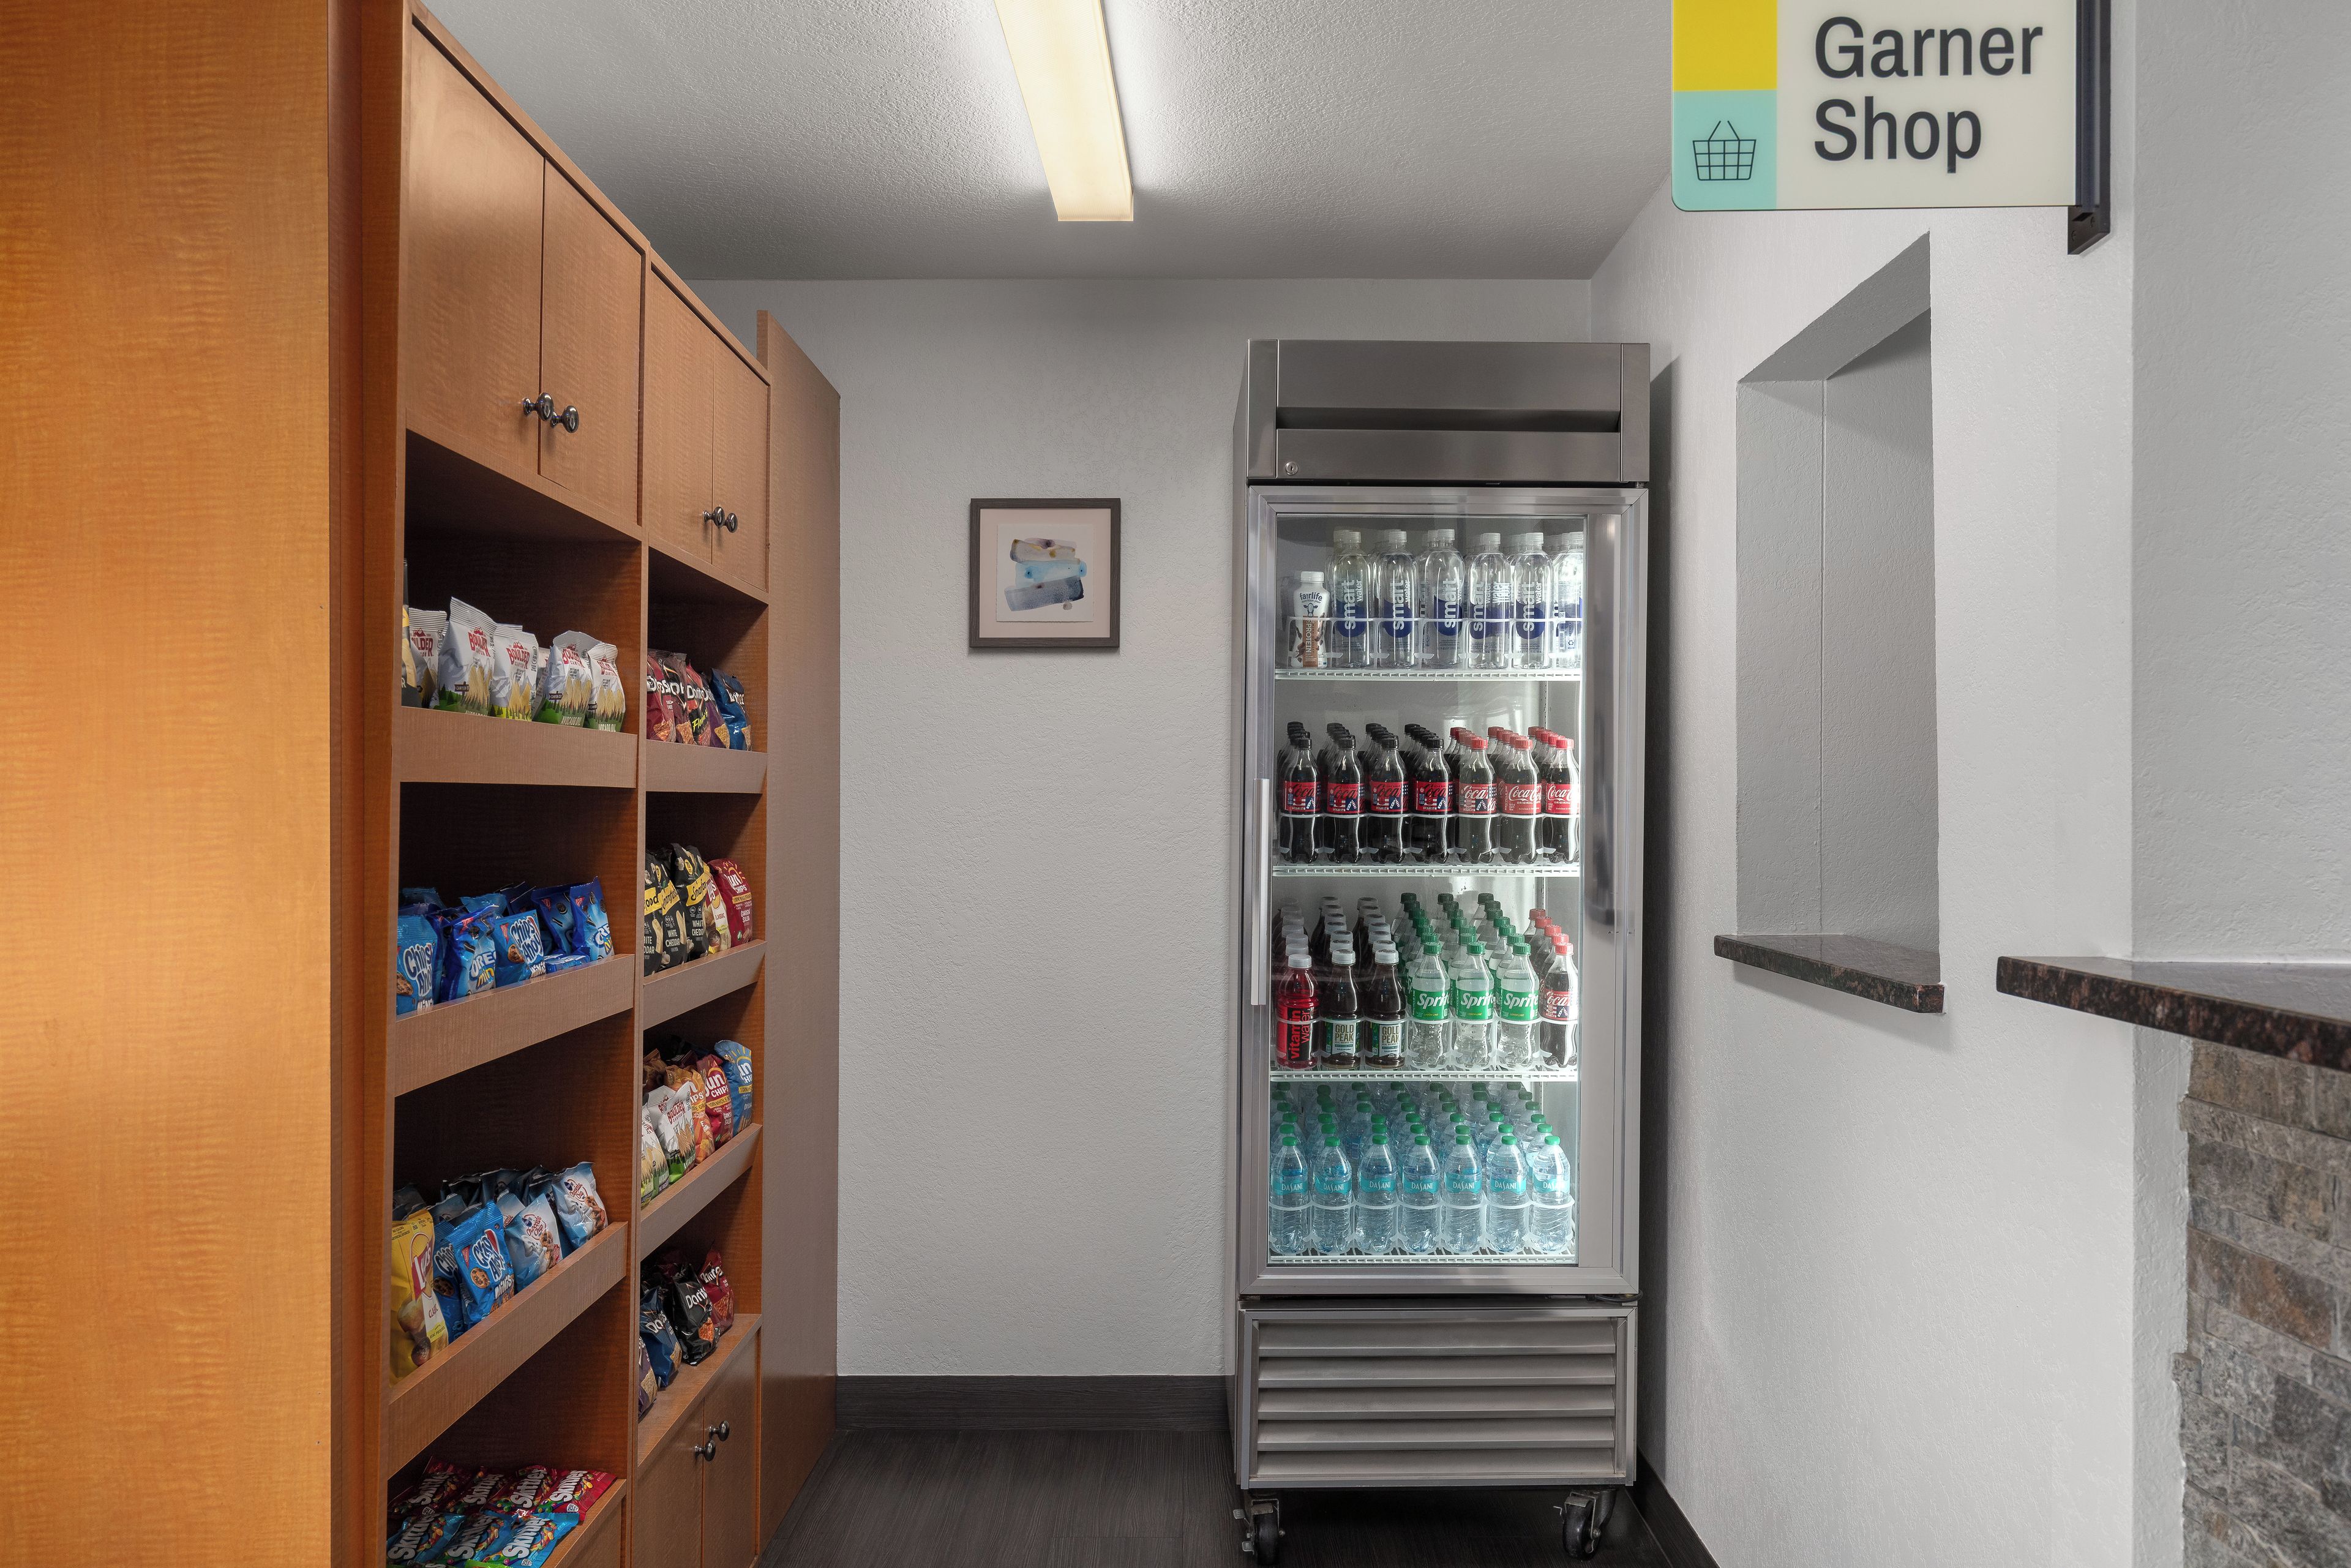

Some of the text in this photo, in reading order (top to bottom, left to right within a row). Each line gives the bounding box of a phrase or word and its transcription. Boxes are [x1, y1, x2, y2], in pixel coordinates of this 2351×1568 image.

[1814, 16, 2044, 79] Garner
[1813, 96, 1982, 174] Shop
[1300, 592, 1322, 601] fairlife
[1341, 580, 1356, 630] smart
[1390, 580, 1404, 630] smart
[1442, 578, 1457, 628] smart
[1474, 581, 1483, 631] smart
[1521, 581, 1535, 631] smart
[411, 637, 433, 657] ULDER
[468, 631, 490, 657] BOULDER
[506, 647, 530, 669] BOULDER
[562, 648, 585, 669] BOULDER
[510, 918, 536, 946] Chips
[521, 932, 543, 962] Ahoy
[666, 939, 680, 948] CHEDDAR
[404, 943, 432, 979] Chips
[530, 961, 546, 978] MINIS
[476, 967, 495, 989] min
[1417, 993, 1450, 1010] Sprit
[1461, 992, 1494, 1009] Sprit
[1504, 992, 1539, 1010] Sprite
[1289, 1010, 1301, 1059] vitamin
[1301, 1010, 1311, 1043] waer
[1335, 1024, 1354, 1033] GOLD
[1335, 1033, 1354, 1041] PEAK
[743, 1075, 752, 1084] HIP
[691, 1092, 704, 1103] IPS
[667, 1101, 686, 1125] BOULDER
[673, 1113, 684, 1122] CANYON
[569, 1183, 583, 1198] Chocolate
[1281, 1183, 1303, 1192] DASANI
[1323, 1183, 1344, 1191] DASANI
[1369, 1180, 1391, 1189] DASANI
[1453, 1182, 1475, 1190] DASANI
[1494, 1180, 1517, 1190] DASANI
[526, 1215, 542, 1237] Chocolate
[534, 1225, 544, 1236] Chip
[495, 1275, 512, 1299] MINIS
[685, 1286, 708, 1309] Dorit
[510, 1469, 548, 1509] Skittles
[549, 1470, 588, 1502] Skittles
[502, 1517, 551, 1558] Skittles
